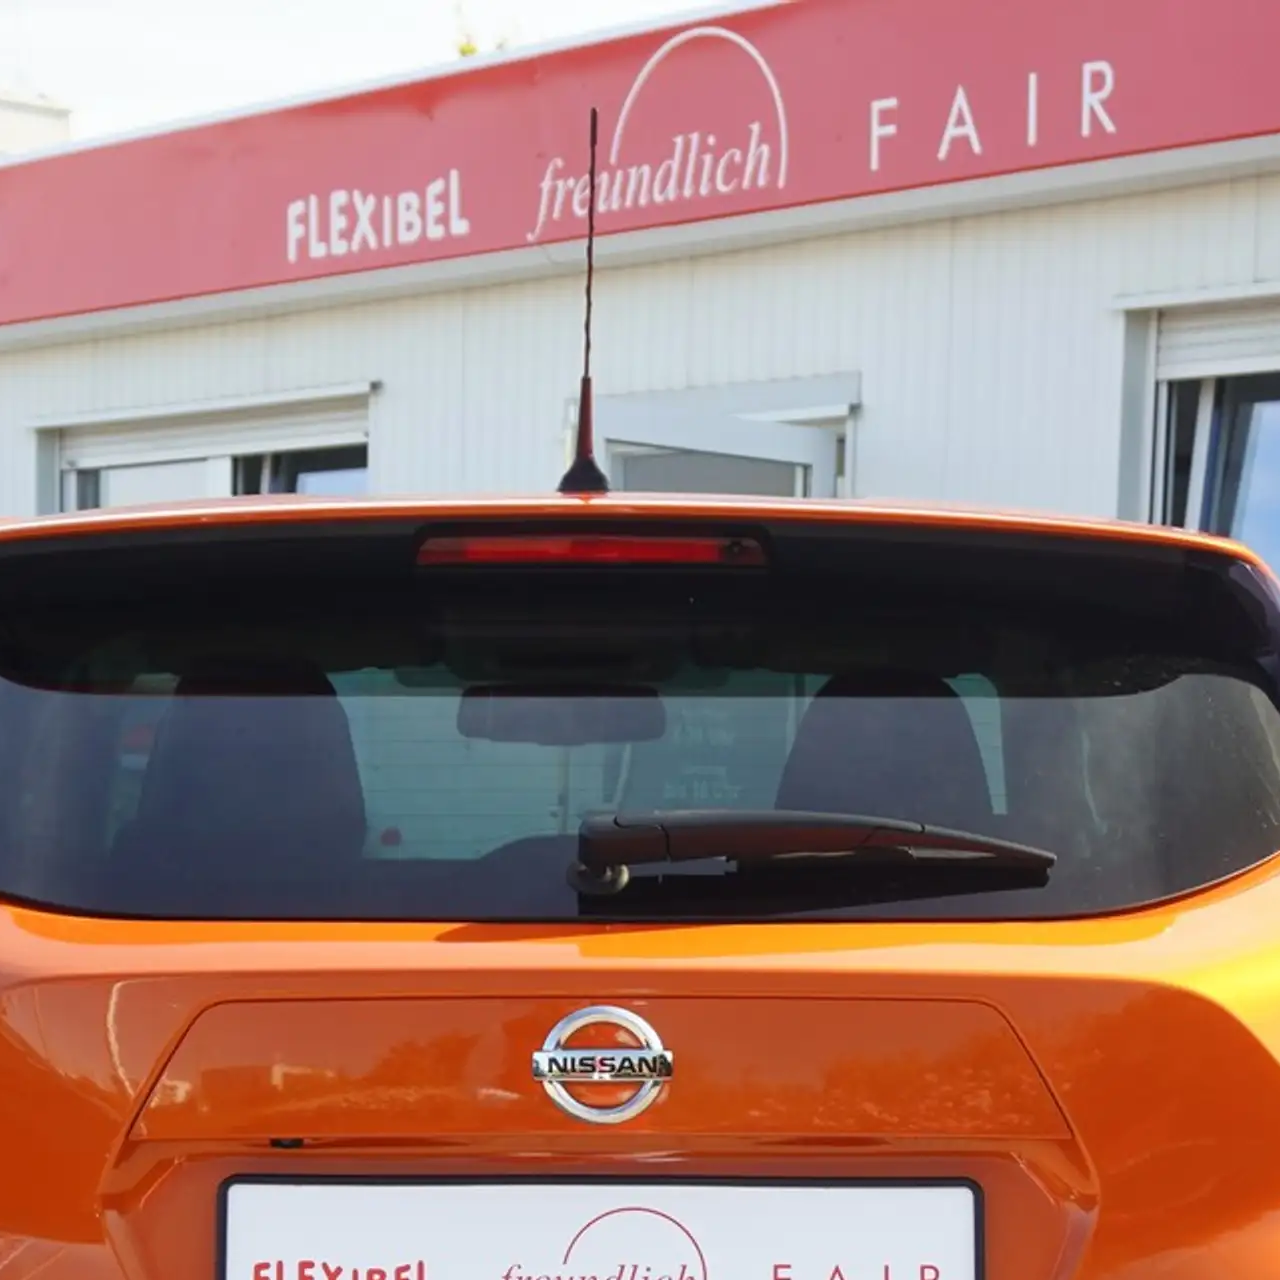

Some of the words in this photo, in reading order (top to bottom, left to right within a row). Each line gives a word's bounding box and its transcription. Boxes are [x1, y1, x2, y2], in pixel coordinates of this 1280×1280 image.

[286, 168, 470, 264] FLEXIBEL
[526, 120, 771, 242] freundlich
[869, 60, 1117, 171] FAIR
[548, 1057, 657, 1073] NISSAN
